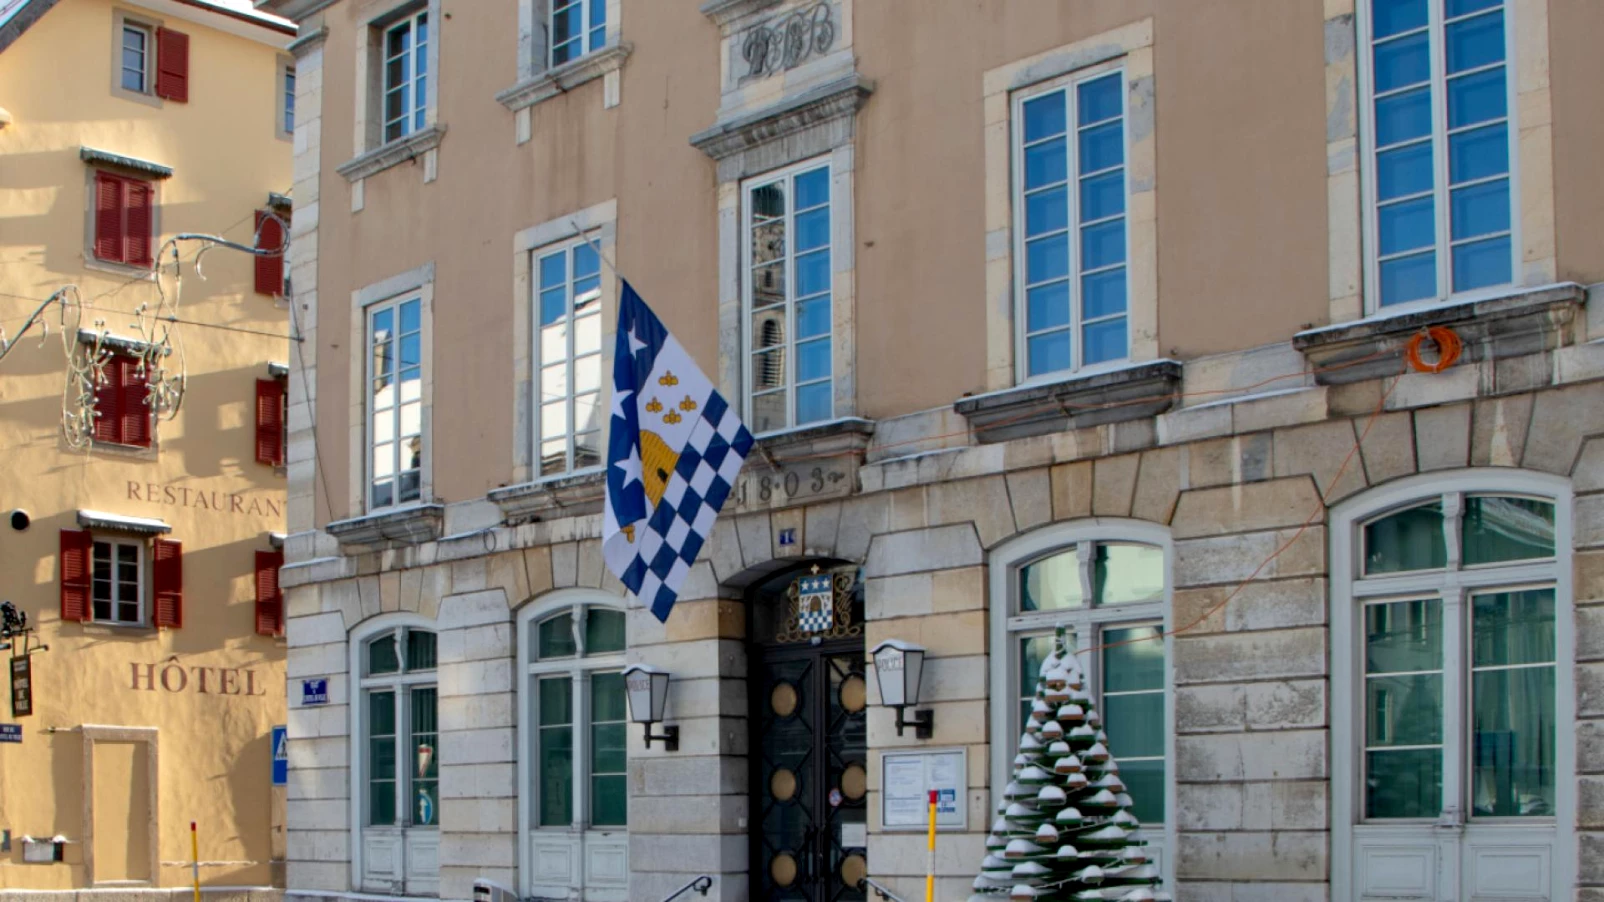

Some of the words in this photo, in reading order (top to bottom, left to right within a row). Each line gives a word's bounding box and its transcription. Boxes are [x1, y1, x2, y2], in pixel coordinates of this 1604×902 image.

[127, 481, 287, 517] RESTAURAN
[129, 655, 266, 697] HÔTEL
[627, 680, 650, 691] POLICE
